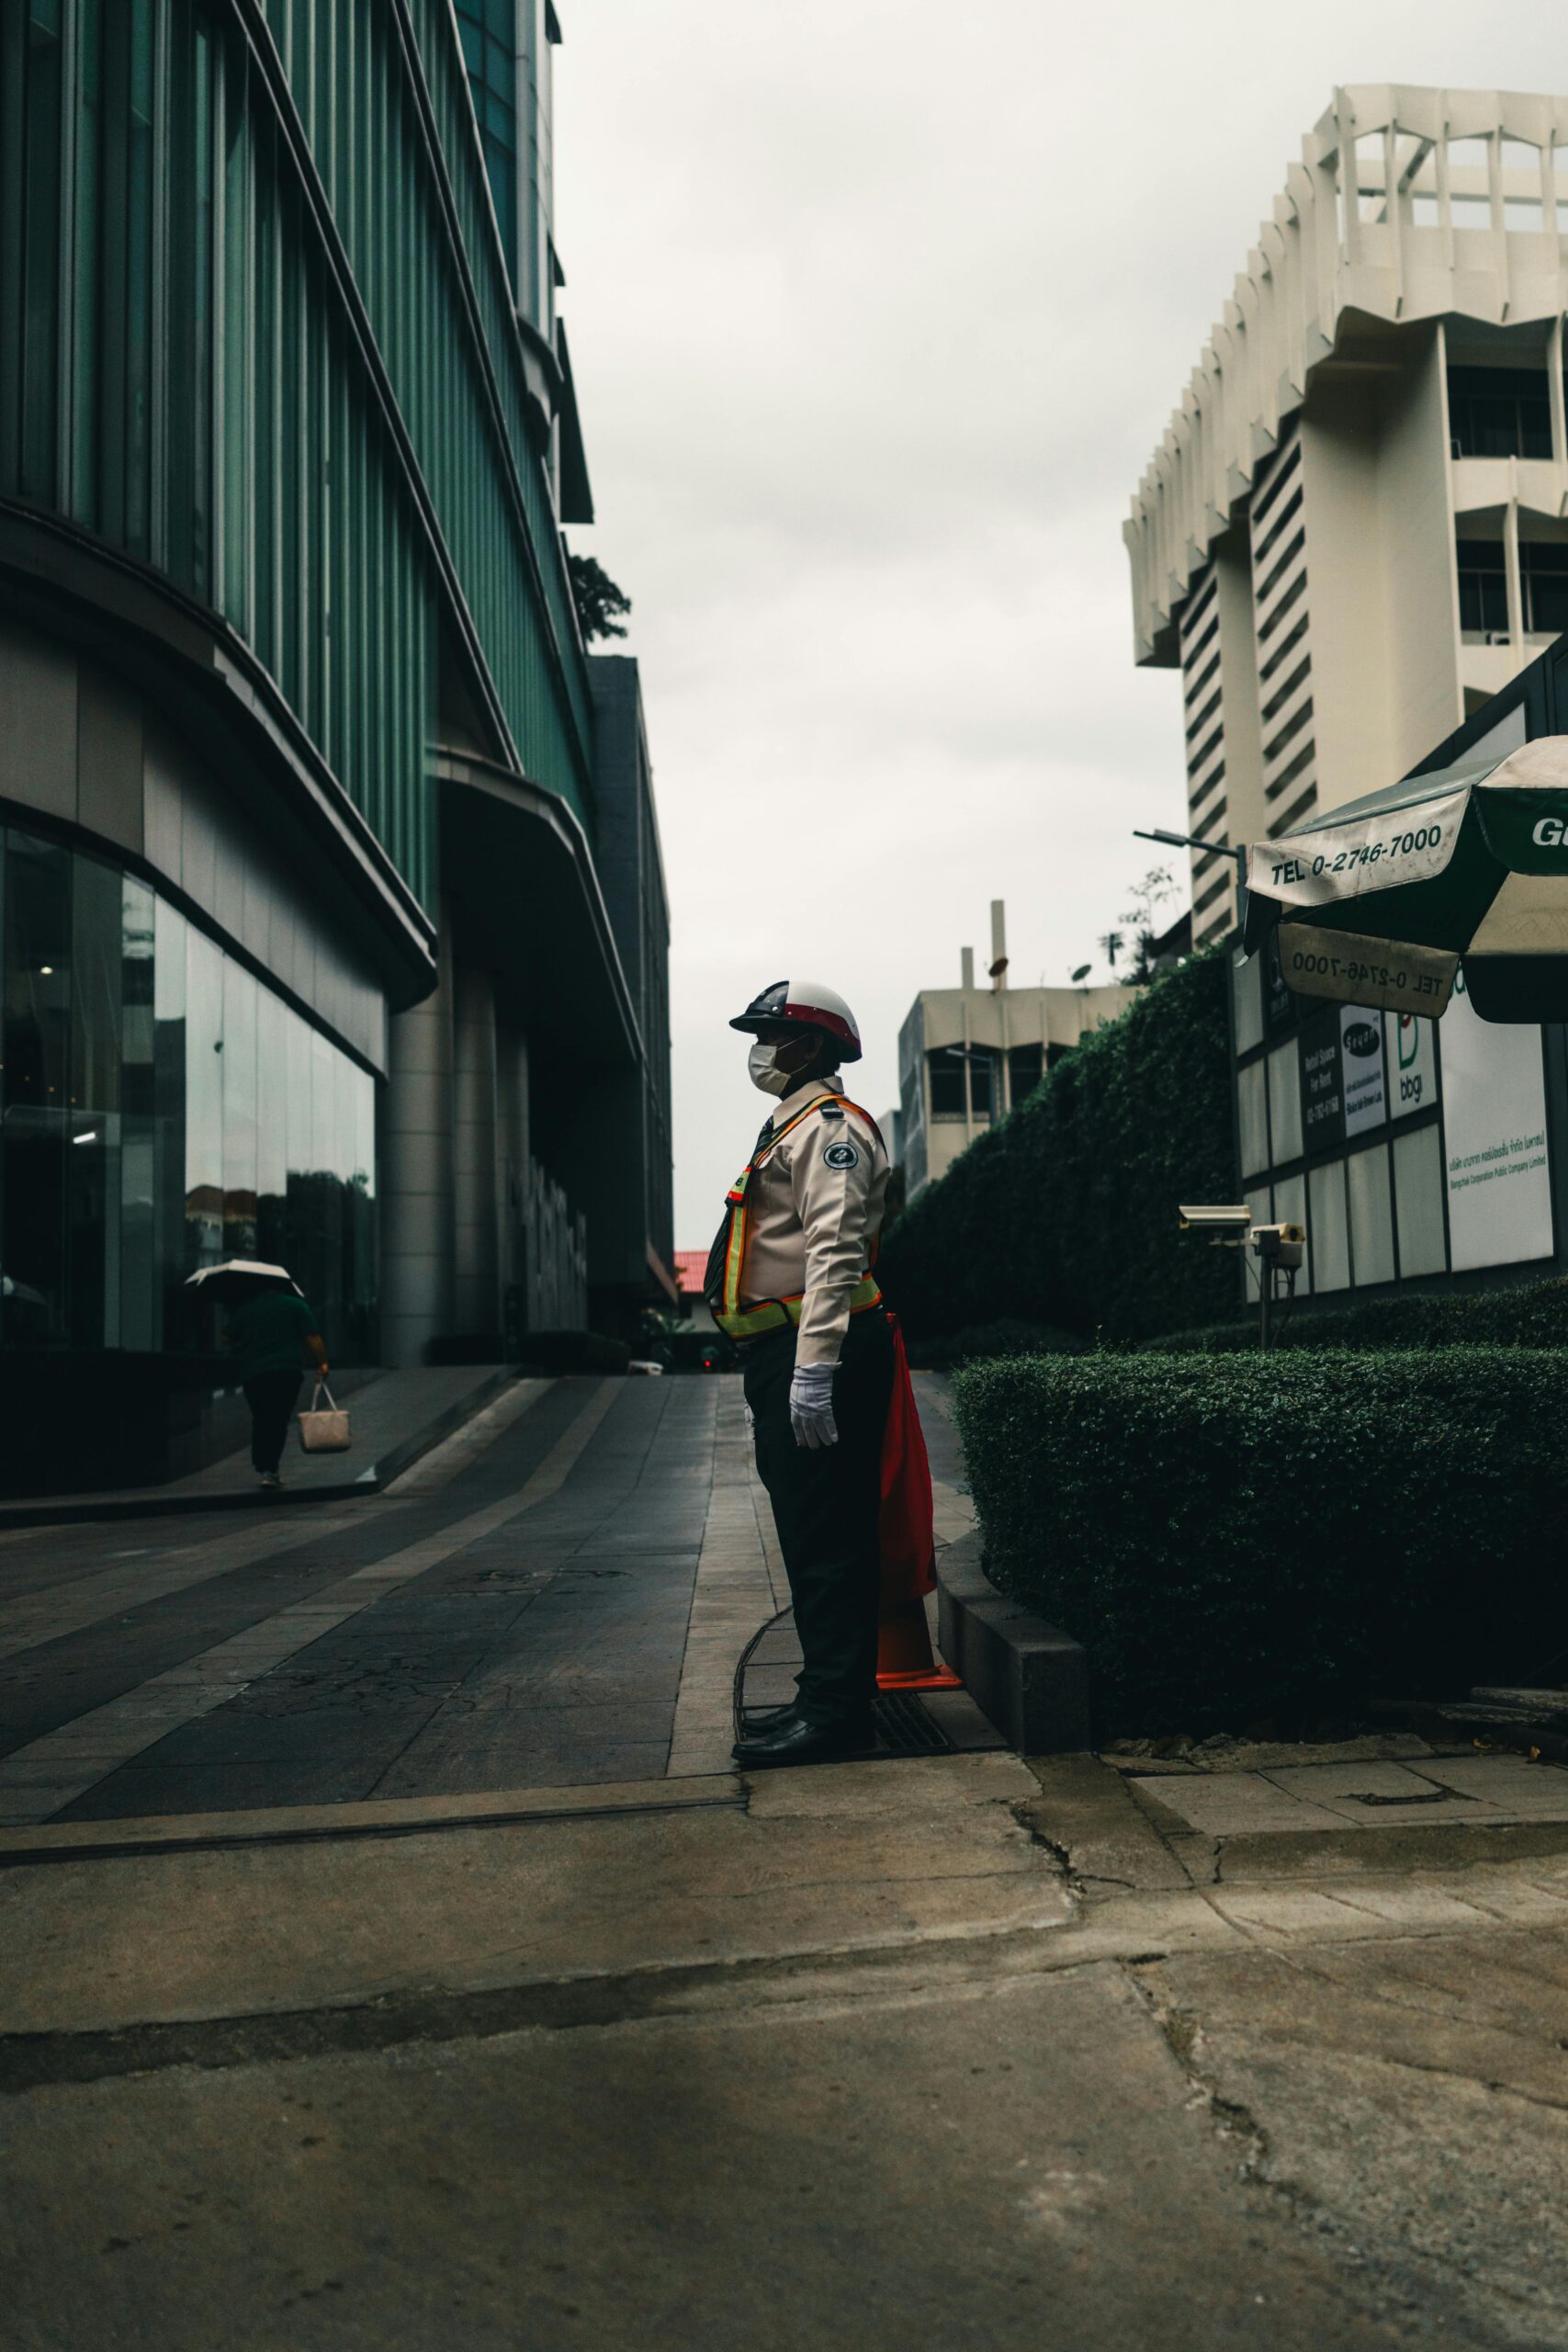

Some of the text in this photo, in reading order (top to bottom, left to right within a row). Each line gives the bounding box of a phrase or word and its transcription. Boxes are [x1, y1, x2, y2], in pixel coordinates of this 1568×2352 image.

[1532, 818, 1568, 846] G
[1272, 825, 1441, 886] TEL 0-2746-7000
